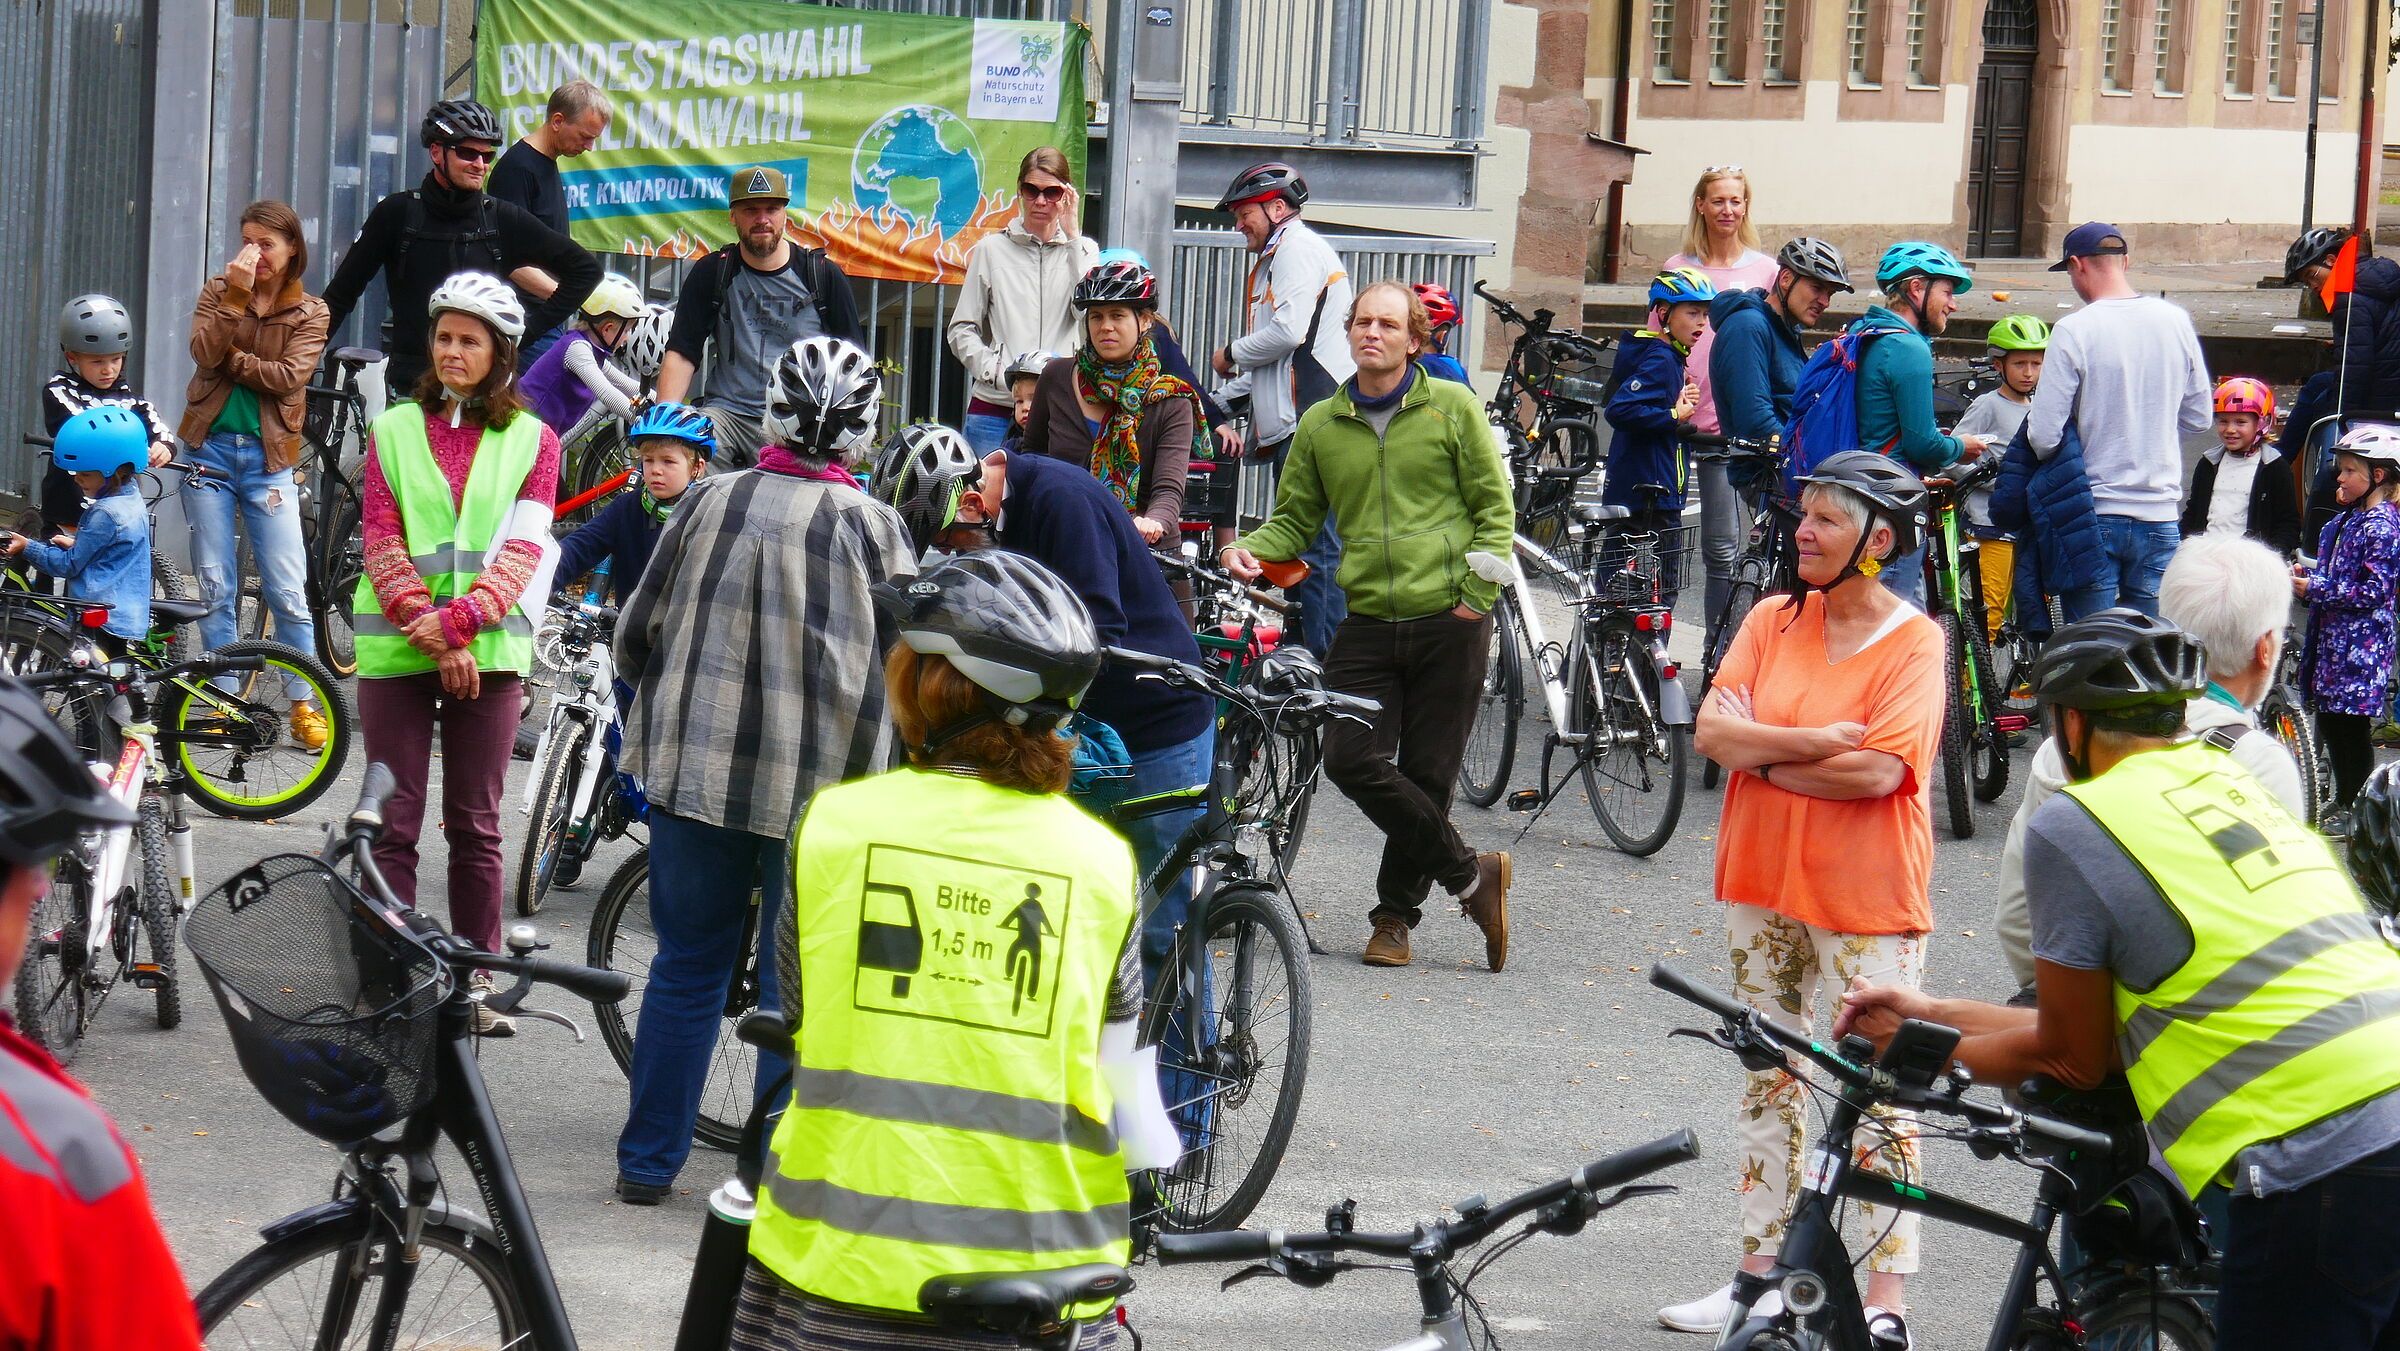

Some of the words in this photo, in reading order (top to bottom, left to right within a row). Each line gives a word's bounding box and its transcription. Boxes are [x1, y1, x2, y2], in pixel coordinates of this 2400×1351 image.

[500, 25, 872, 96] BUNDESTAGSWAHL
[986, 65, 1020, 77] BUND
[983, 92, 992, 103] in
[994, 93, 1027, 106] Bayern
[1029, 95, 1044, 105] e.V.
[985, 80, 1045, 92] Naturschutz
[592, 92, 812, 151] LIMAWAHL
[596, 176, 727, 206] KLIMAPOLITIK
[909, 581, 940, 594] KED
[936, 885, 991, 916] Bitte
[931, 928, 966, 957] 1,5
[972, 940, 993, 960] m
[466, 1141, 483, 1170] BIKE
[478, 1174, 513, 1256] MANUFAKTUR
